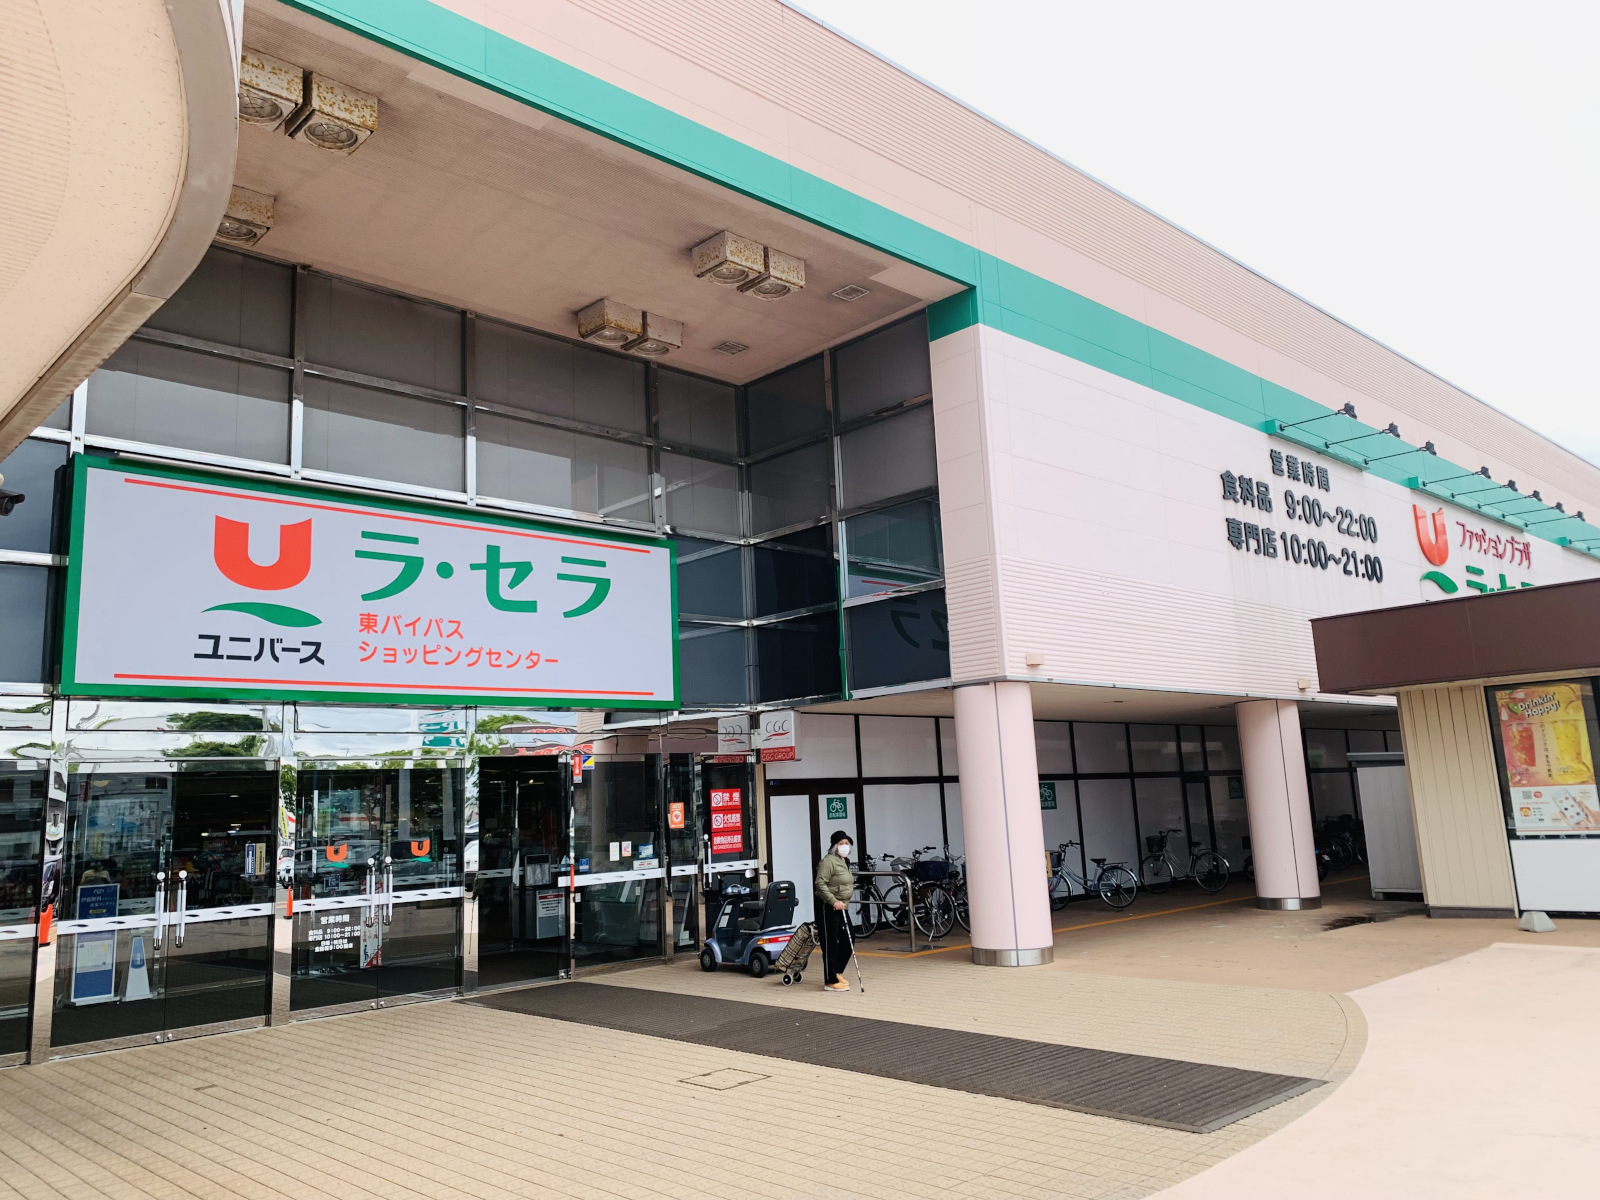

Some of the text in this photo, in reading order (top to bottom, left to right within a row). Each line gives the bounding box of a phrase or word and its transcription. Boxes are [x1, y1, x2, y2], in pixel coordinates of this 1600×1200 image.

[1270, 449, 1330, 492] 営業時間
[1220, 470, 1378, 543] 食料品 9:00～22:00
[1226, 518, 1383, 583] 専門店 10:00～21:00
[1456, 521, 1531, 569] ファッションプラザ
[355, 530, 611, 618] ラ・セラ
[358, 612, 464, 639] 東バイパス
[194, 634, 325, 666] ユニバース
[358, 641, 558, 669] ショッピングセンター
[1518, 692, 1556, 711] Drinkin'
[1525, 701, 1561, 718] Happy!
[766, 720, 789, 733] CGC
[774, 752, 794, 760] GROUP
[320, 914, 350, 925] 営業時間
